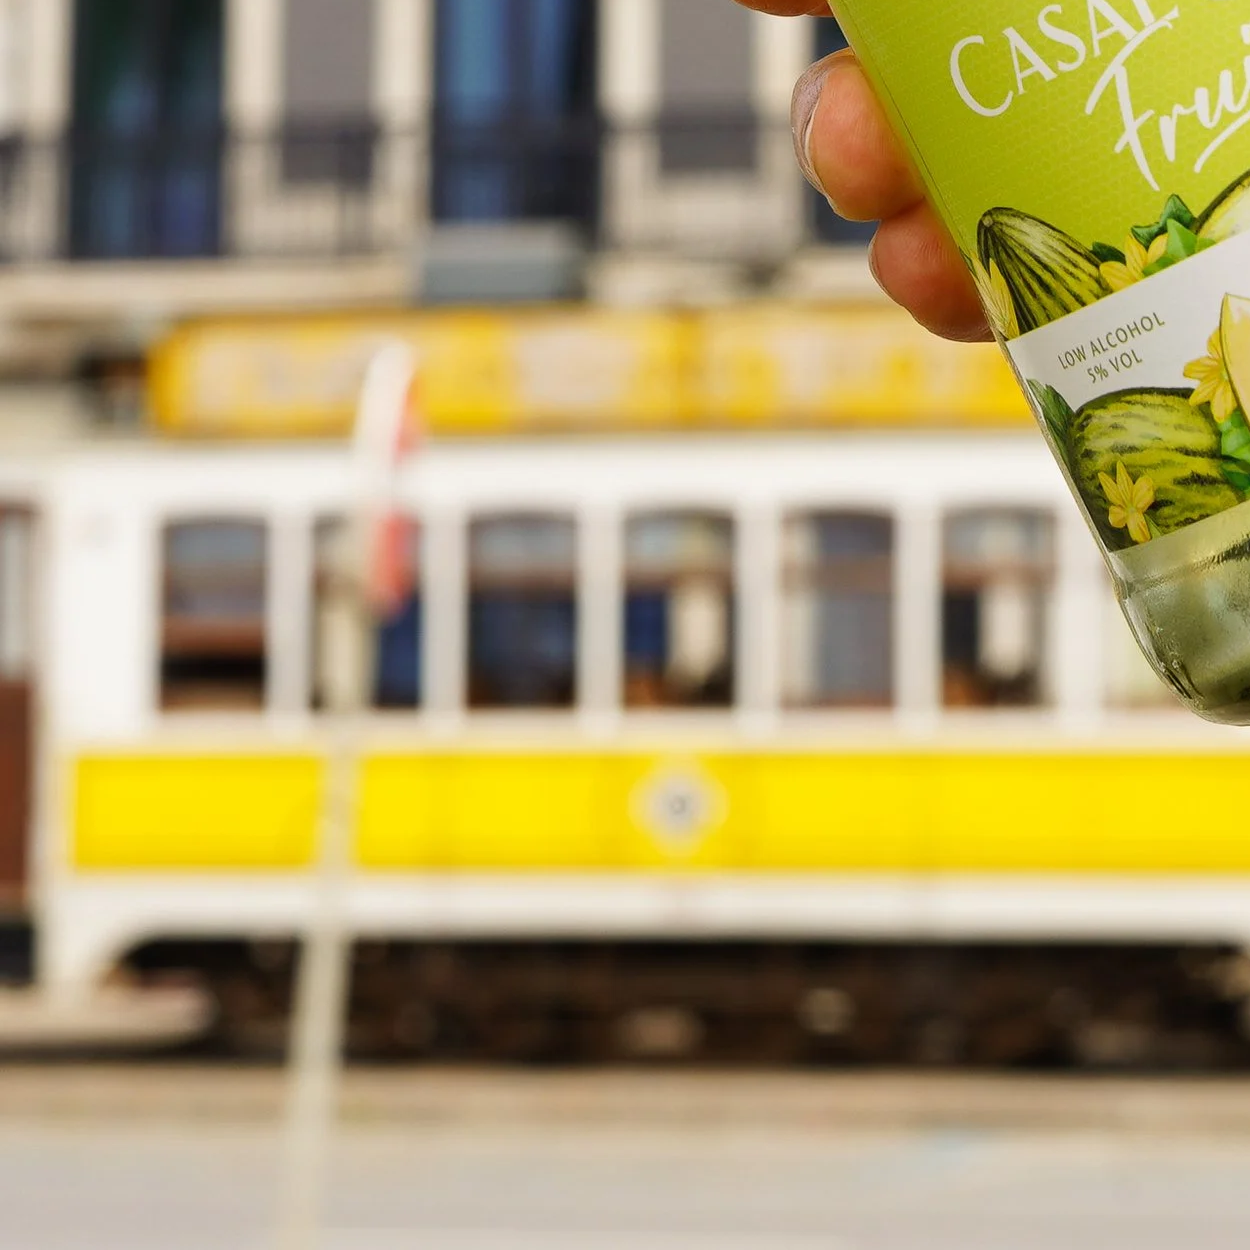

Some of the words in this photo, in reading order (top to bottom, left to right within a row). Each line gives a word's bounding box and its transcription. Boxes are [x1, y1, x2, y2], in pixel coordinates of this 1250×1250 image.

[1057, 344, 1087, 370] LOW
[1089, 311, 1165, 358] ALCOHOL
[1087, 364, 1109, 384] 5%
[1109, 349, 1143, 374] VOL
